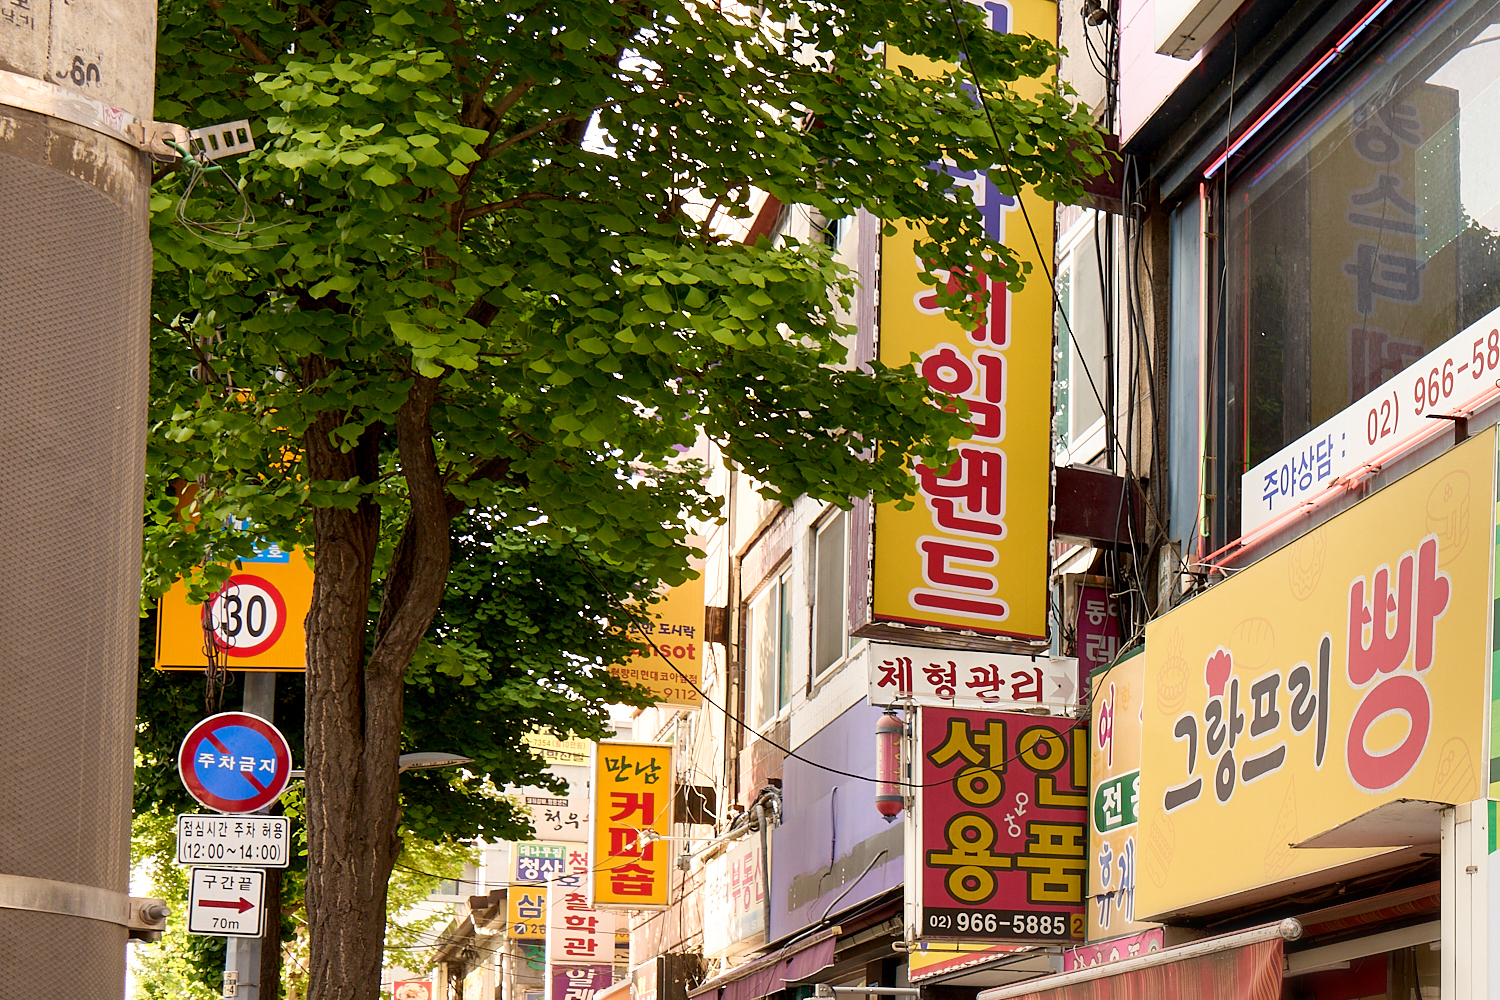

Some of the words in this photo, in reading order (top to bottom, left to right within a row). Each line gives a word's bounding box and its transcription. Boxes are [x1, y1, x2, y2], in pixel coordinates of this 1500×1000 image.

[1262, 434, 1334, 511] 주야상담
[1367, 389, 1400, 447] 02)
[221, 594, 267, 638] 30
[658, 622, 696, 639] 도시락
[1347, 537, 1451, 792] 빵
[876, 655, 1044, 704] 체형관리
[1164, 636, 1331, 812] 그랑프리
[197, 751, 277, 776] 주차금지
[605, 755, 662, 785] 만남
[929, 718, 1088, 807] 성인
[183, 820, 228, 839] 점심시간
[234, 820, 257, 840] 주차
[262, 820, 284, 840] 허용
[183, 841, 282, 862] (12:00~14:00)
[520, 842, 564, 857] 대나무집
[609, 791, 655, 896] 커피숍
[518, 857, 564, 881] 청산
[929, 813, 1087, 904] 용품
[202, 874, 254, 890] 구간끝
[518, 894, 545, 918] 삼
[212, 917, 240, 930] 70m
[929, 914, 952, 930] 02)
[957, 910, 1066, 936] 966-5885
